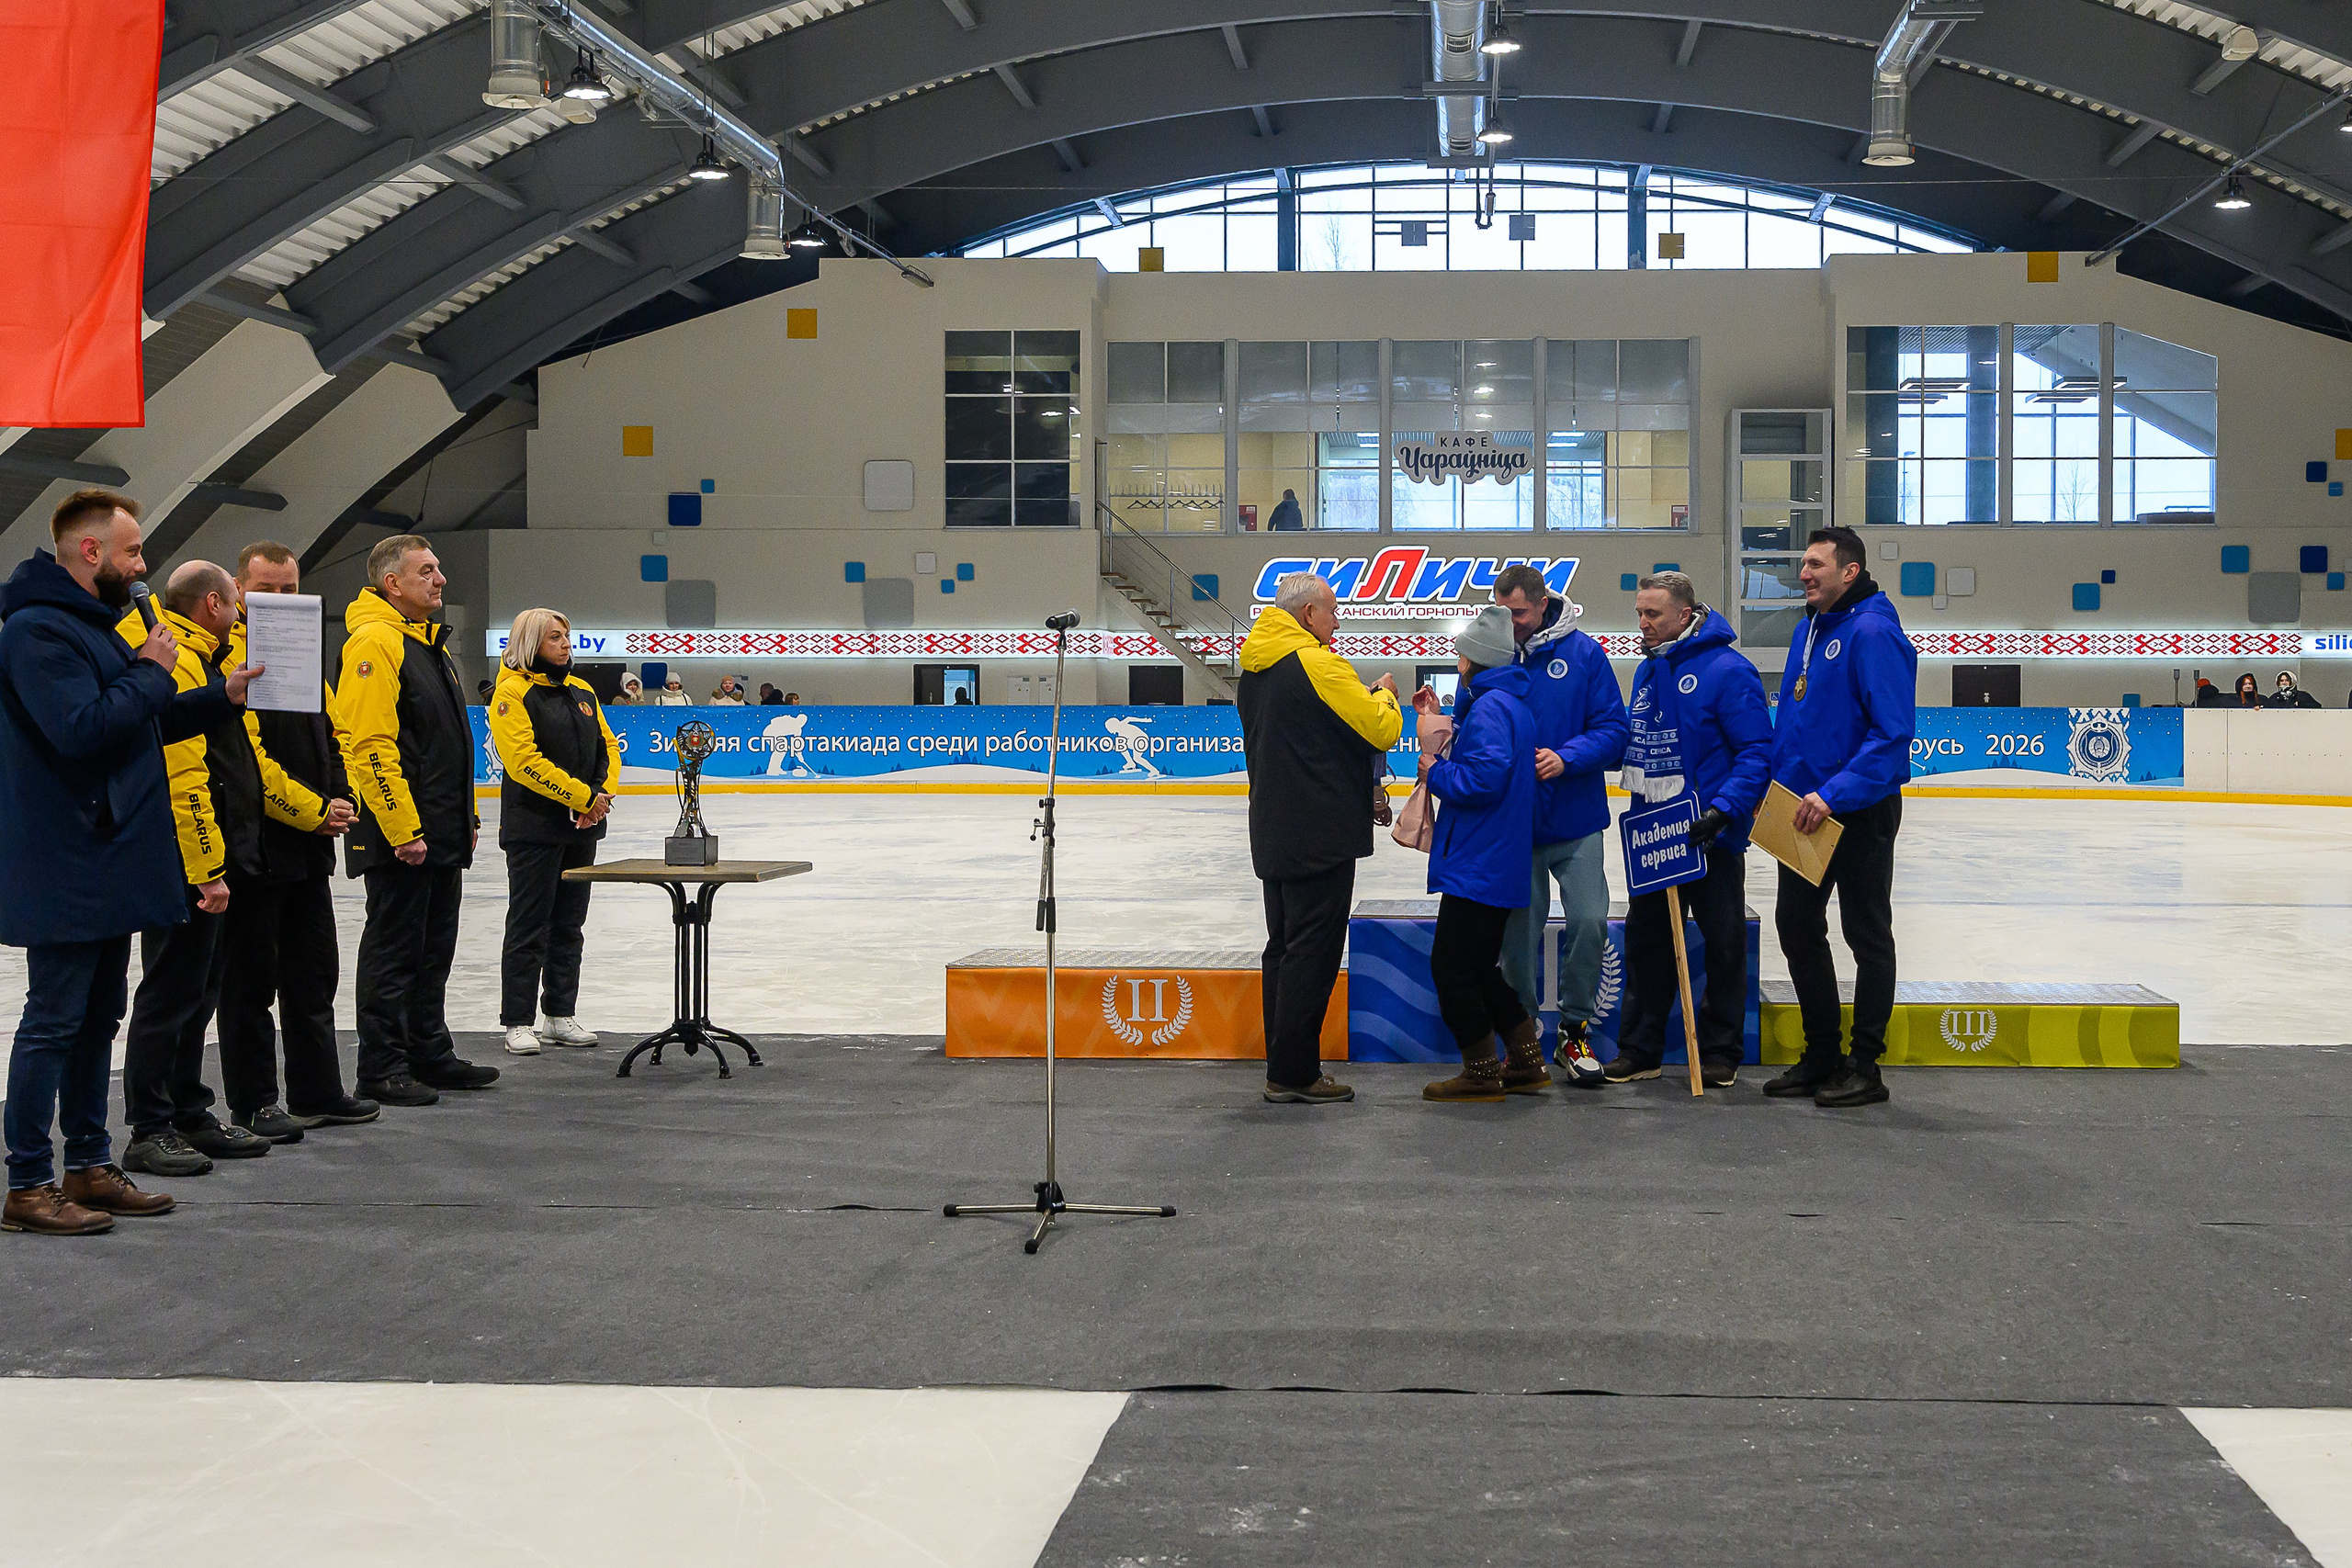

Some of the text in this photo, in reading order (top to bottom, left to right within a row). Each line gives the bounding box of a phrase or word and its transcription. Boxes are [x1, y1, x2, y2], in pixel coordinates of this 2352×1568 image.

[1440, 436, 1488, 448] КАФЕ
[1399, 446, 1529, 479] Чараўніца
[747, 735, 901, 758] спартакиада
[907, 735, 978, 758] среди
[985, 729, 1129, 758] работников
[1133, 735, 1245, 758] организа
[1984, 733, 2046, 757] 2026
[368, 751, 398, 812] BELARUS
[523, 765, 573, 801] BELARUS
[188, 793, 212, 855] BELARUS
[1632, 818, 1690, 850] Академия
[1641, 843, 1688, 870] сервиса
[1125, 978, 1169, 1021] II
[1949, 1010, 1989, 1036] III
